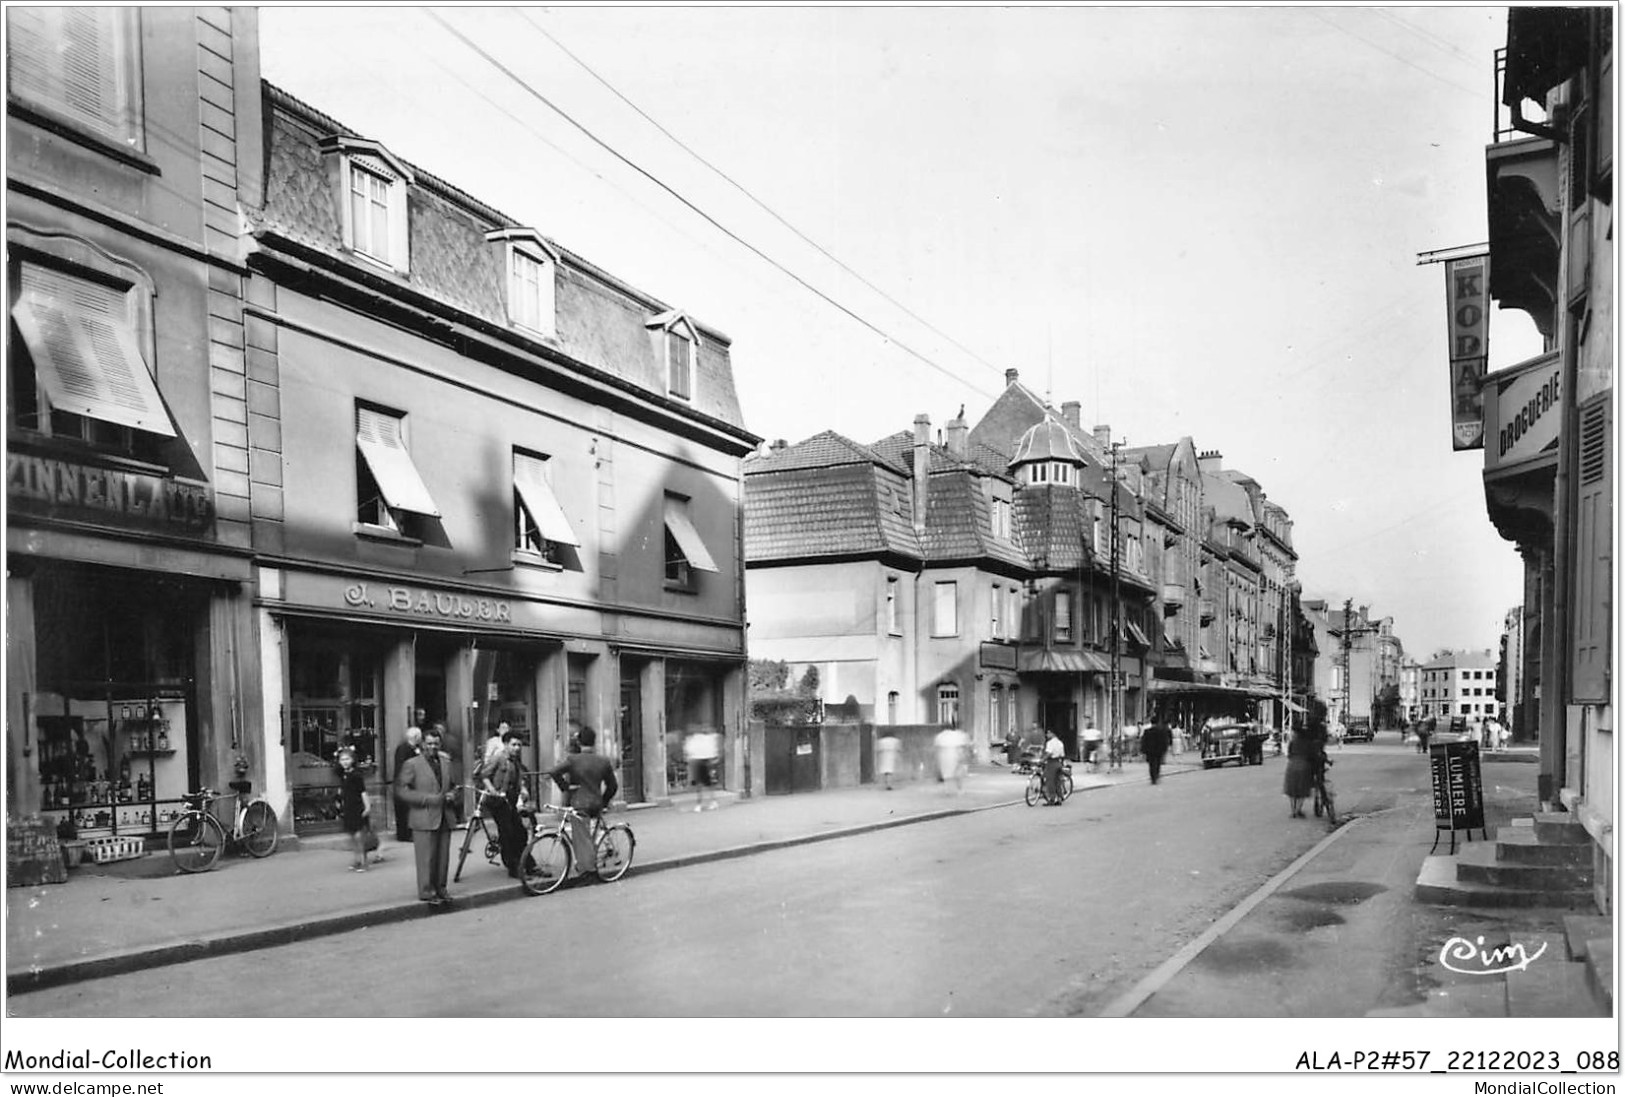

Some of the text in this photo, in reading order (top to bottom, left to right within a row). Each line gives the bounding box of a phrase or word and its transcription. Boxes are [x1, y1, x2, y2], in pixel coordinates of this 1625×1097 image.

[1456, 274, 1483, 415] KODAK
[1499, 371, 1560, 458] DROGUERIE
[389, 586, 511, 624] BAULER
[1450, 756, 1467, 816] LUMIERE
